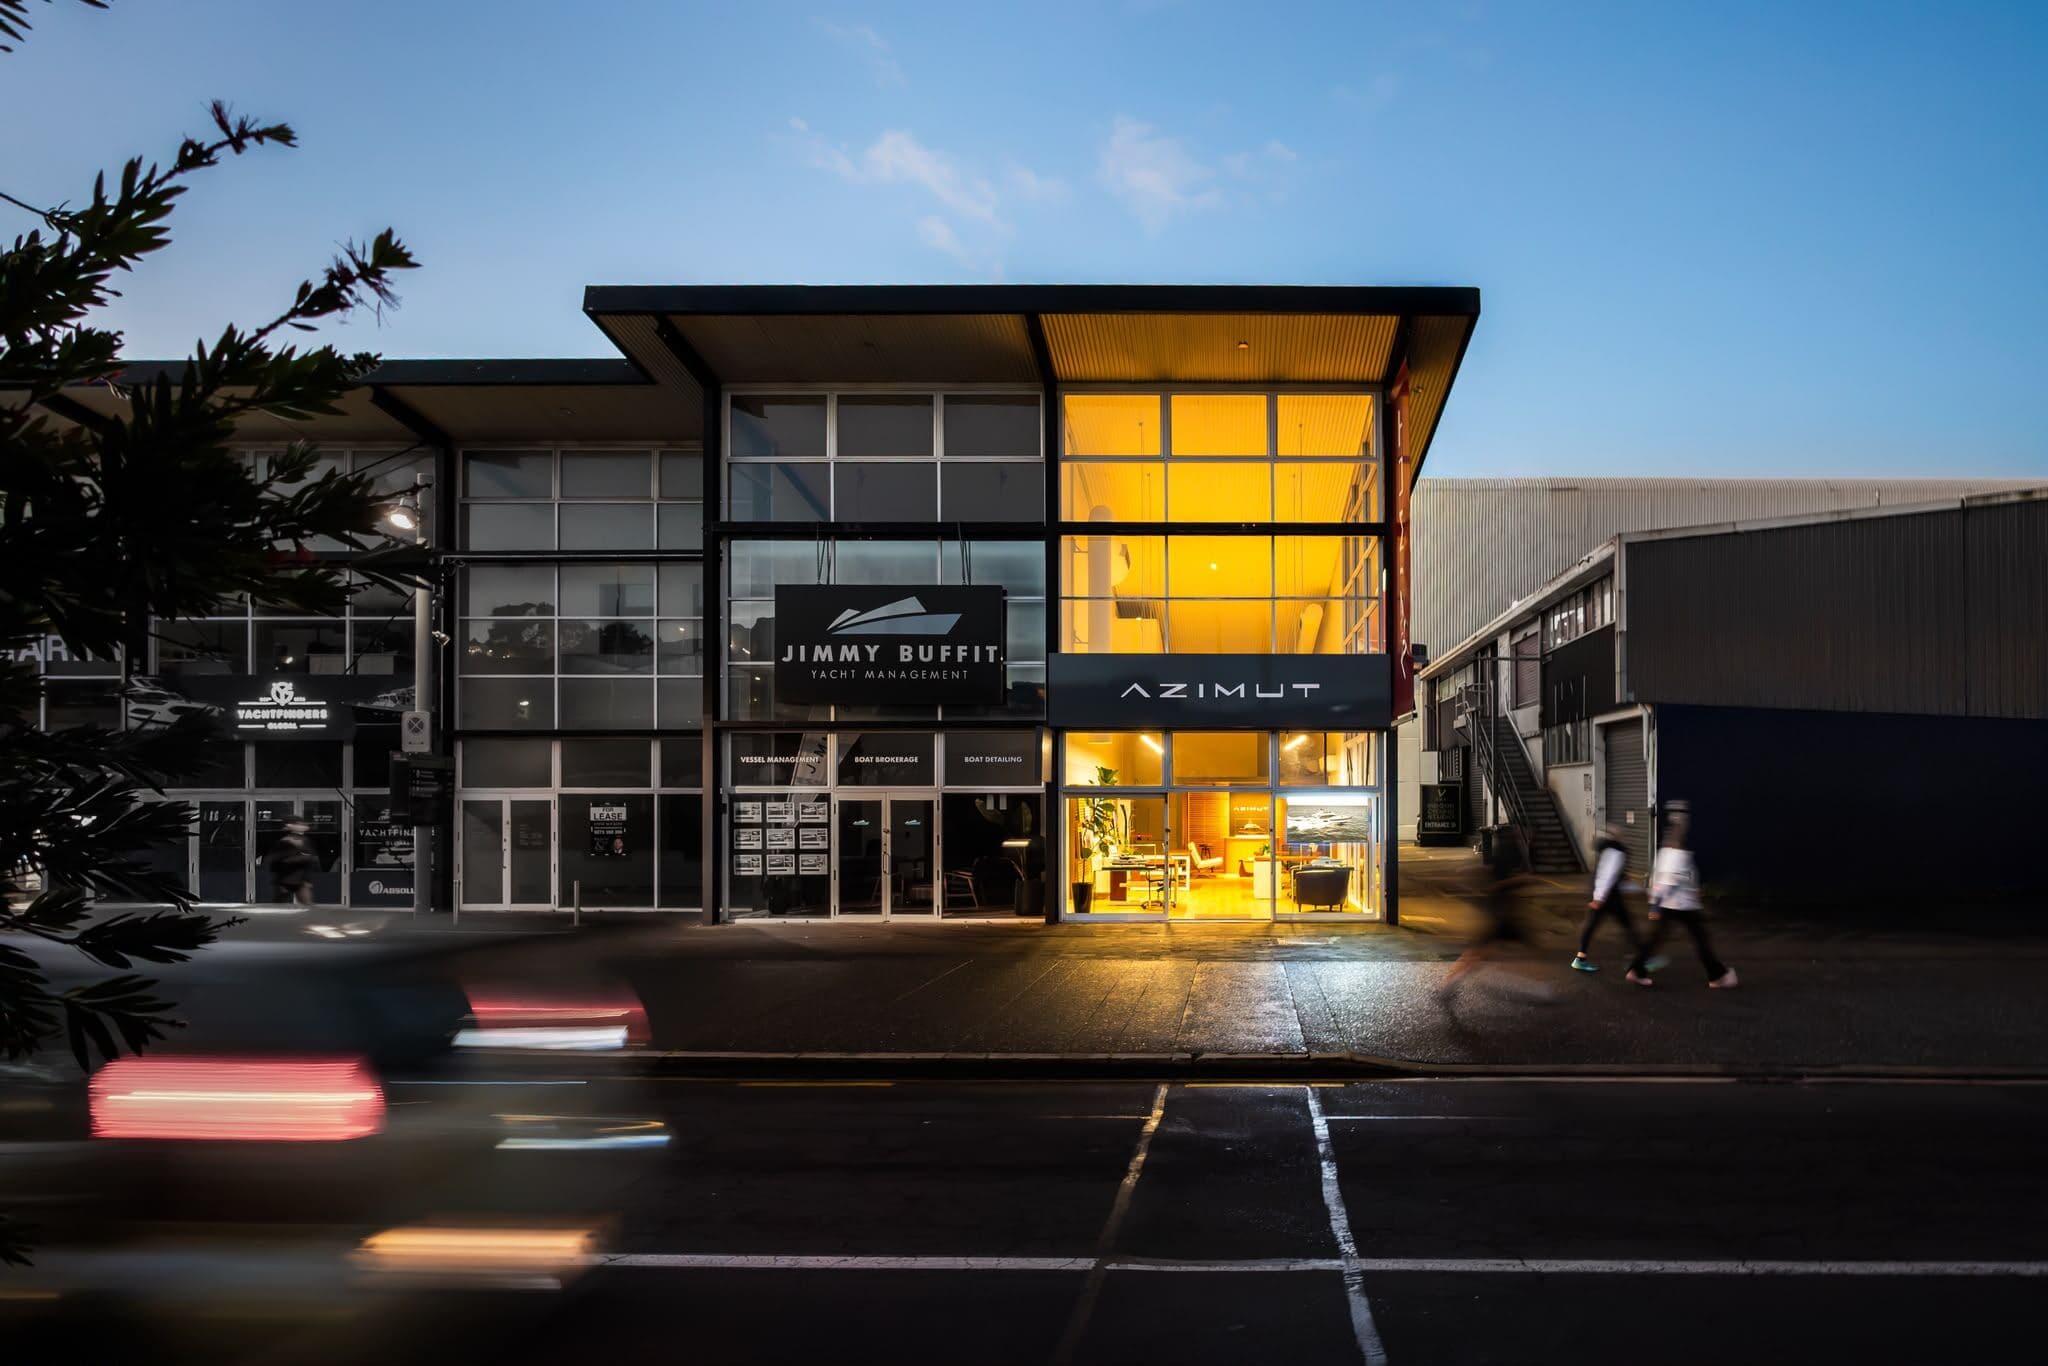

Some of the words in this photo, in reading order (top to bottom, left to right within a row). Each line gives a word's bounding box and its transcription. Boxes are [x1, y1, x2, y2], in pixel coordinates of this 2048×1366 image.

[782, 645, 880, 662] JIMMY
[899, 645, 998, 663] BUFFIT
[811, 670, 856, 680] YACHT
[864, 670, 968, 681] MANAGEMENT
[1120, 682, 1321, 698] AZIMUT
[237, 709, 328, 719] YACHTFINDERS
